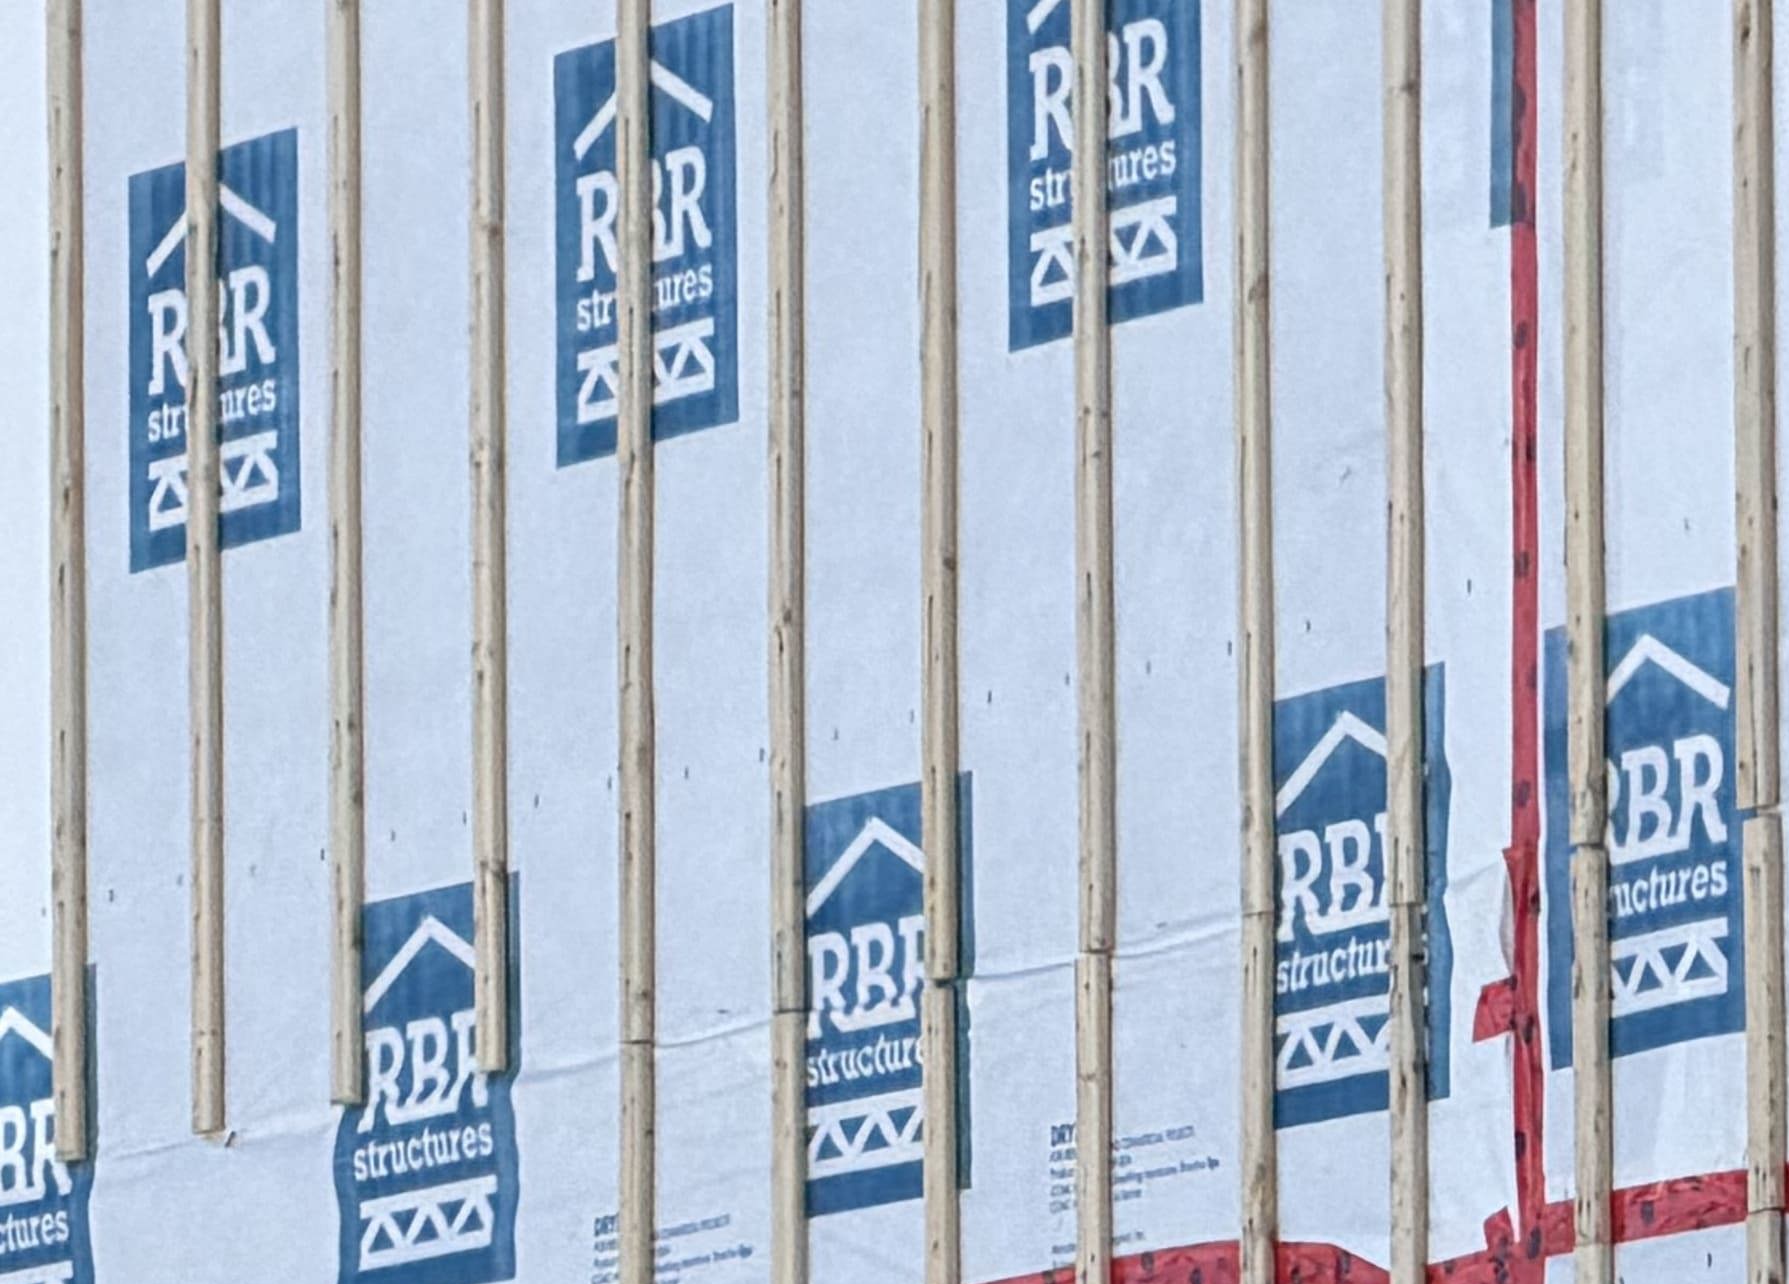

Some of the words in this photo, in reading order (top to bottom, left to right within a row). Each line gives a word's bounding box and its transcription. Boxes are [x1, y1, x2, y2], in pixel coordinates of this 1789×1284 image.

[1030, 139, 1177, 212] strures
[575, 145, 713, 283] RR
[146, 264, 277, 396] RR
[576, 263, 714, 332] strures
[146, 380, 277, 443] strures
[1277, 812, 1387, 942] RB
[1609, 859, 1727, 915] uctures
[1277, 934, 1389, 995] structur
[353, 1122, 492, 1181] structures
